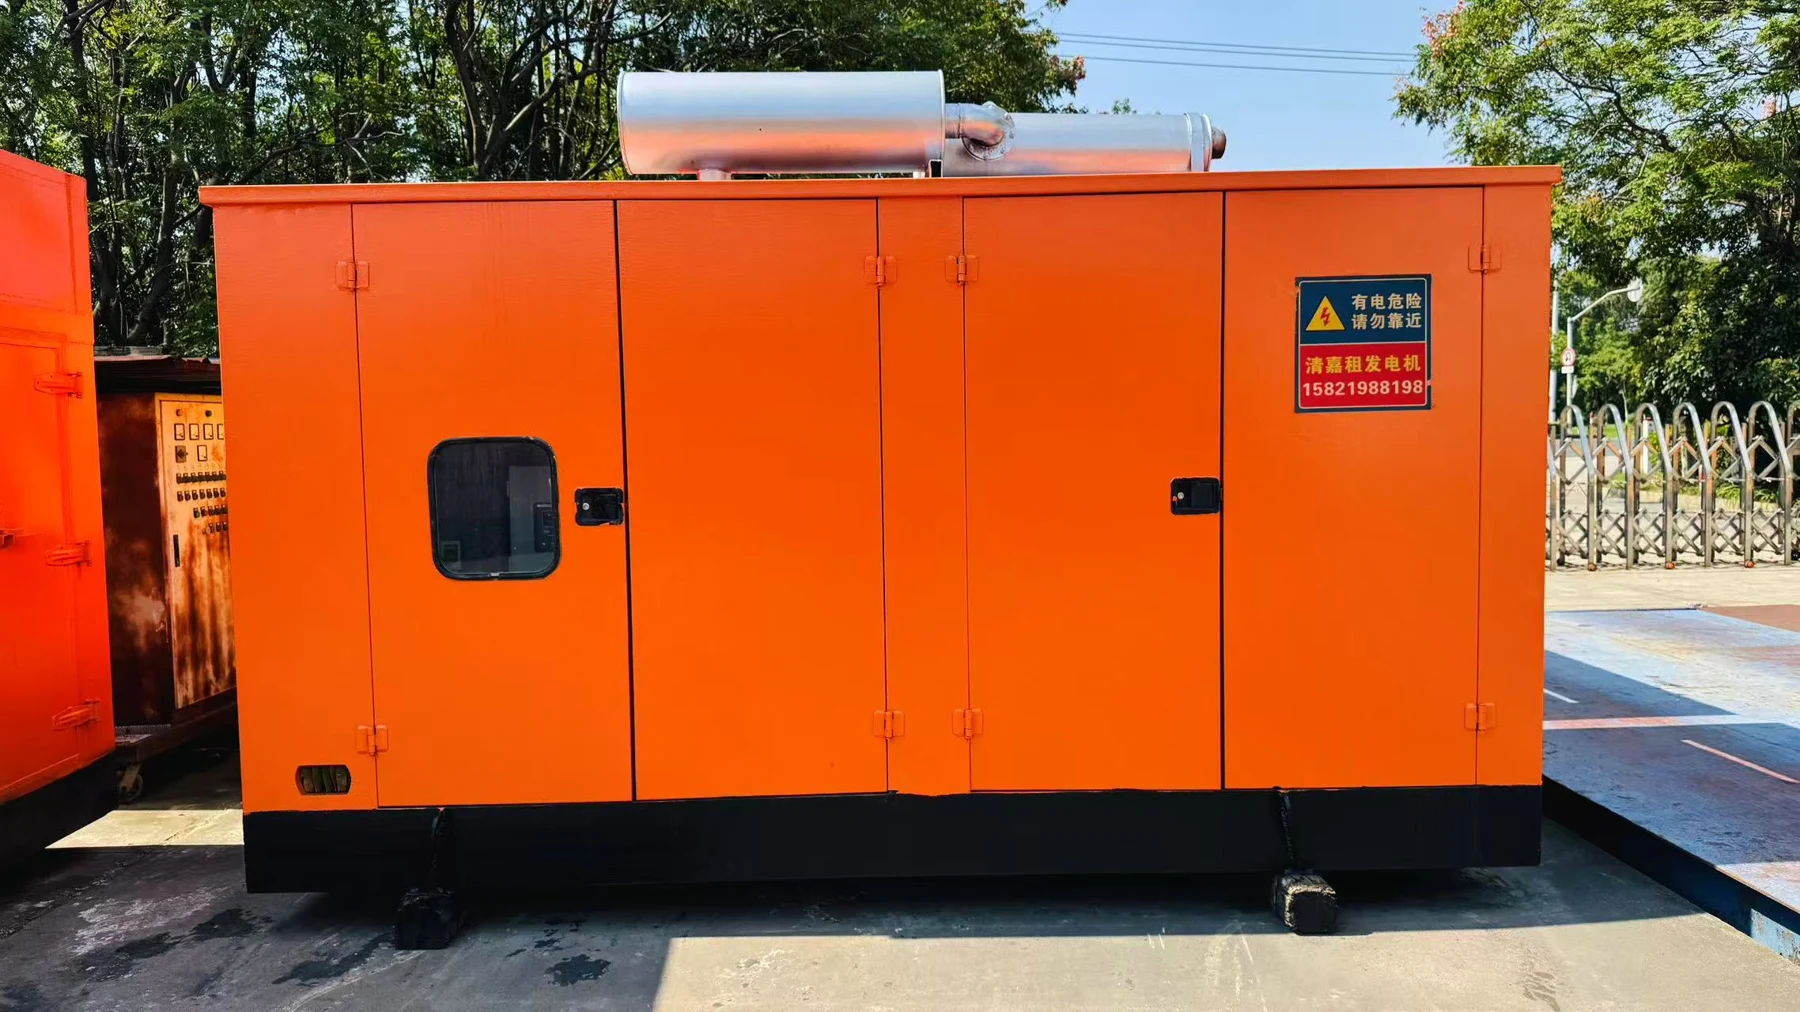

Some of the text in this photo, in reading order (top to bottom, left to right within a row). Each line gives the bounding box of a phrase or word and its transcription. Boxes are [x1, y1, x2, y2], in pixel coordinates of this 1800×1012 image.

[1351, 293, 1422, 310] 有电危险
[1351, 313, 1422, 330] 请勿靠近
[1305, 355, 1421, 375] 清嘉租发电机
[1303, 380, 1423, 396] 15821988198
